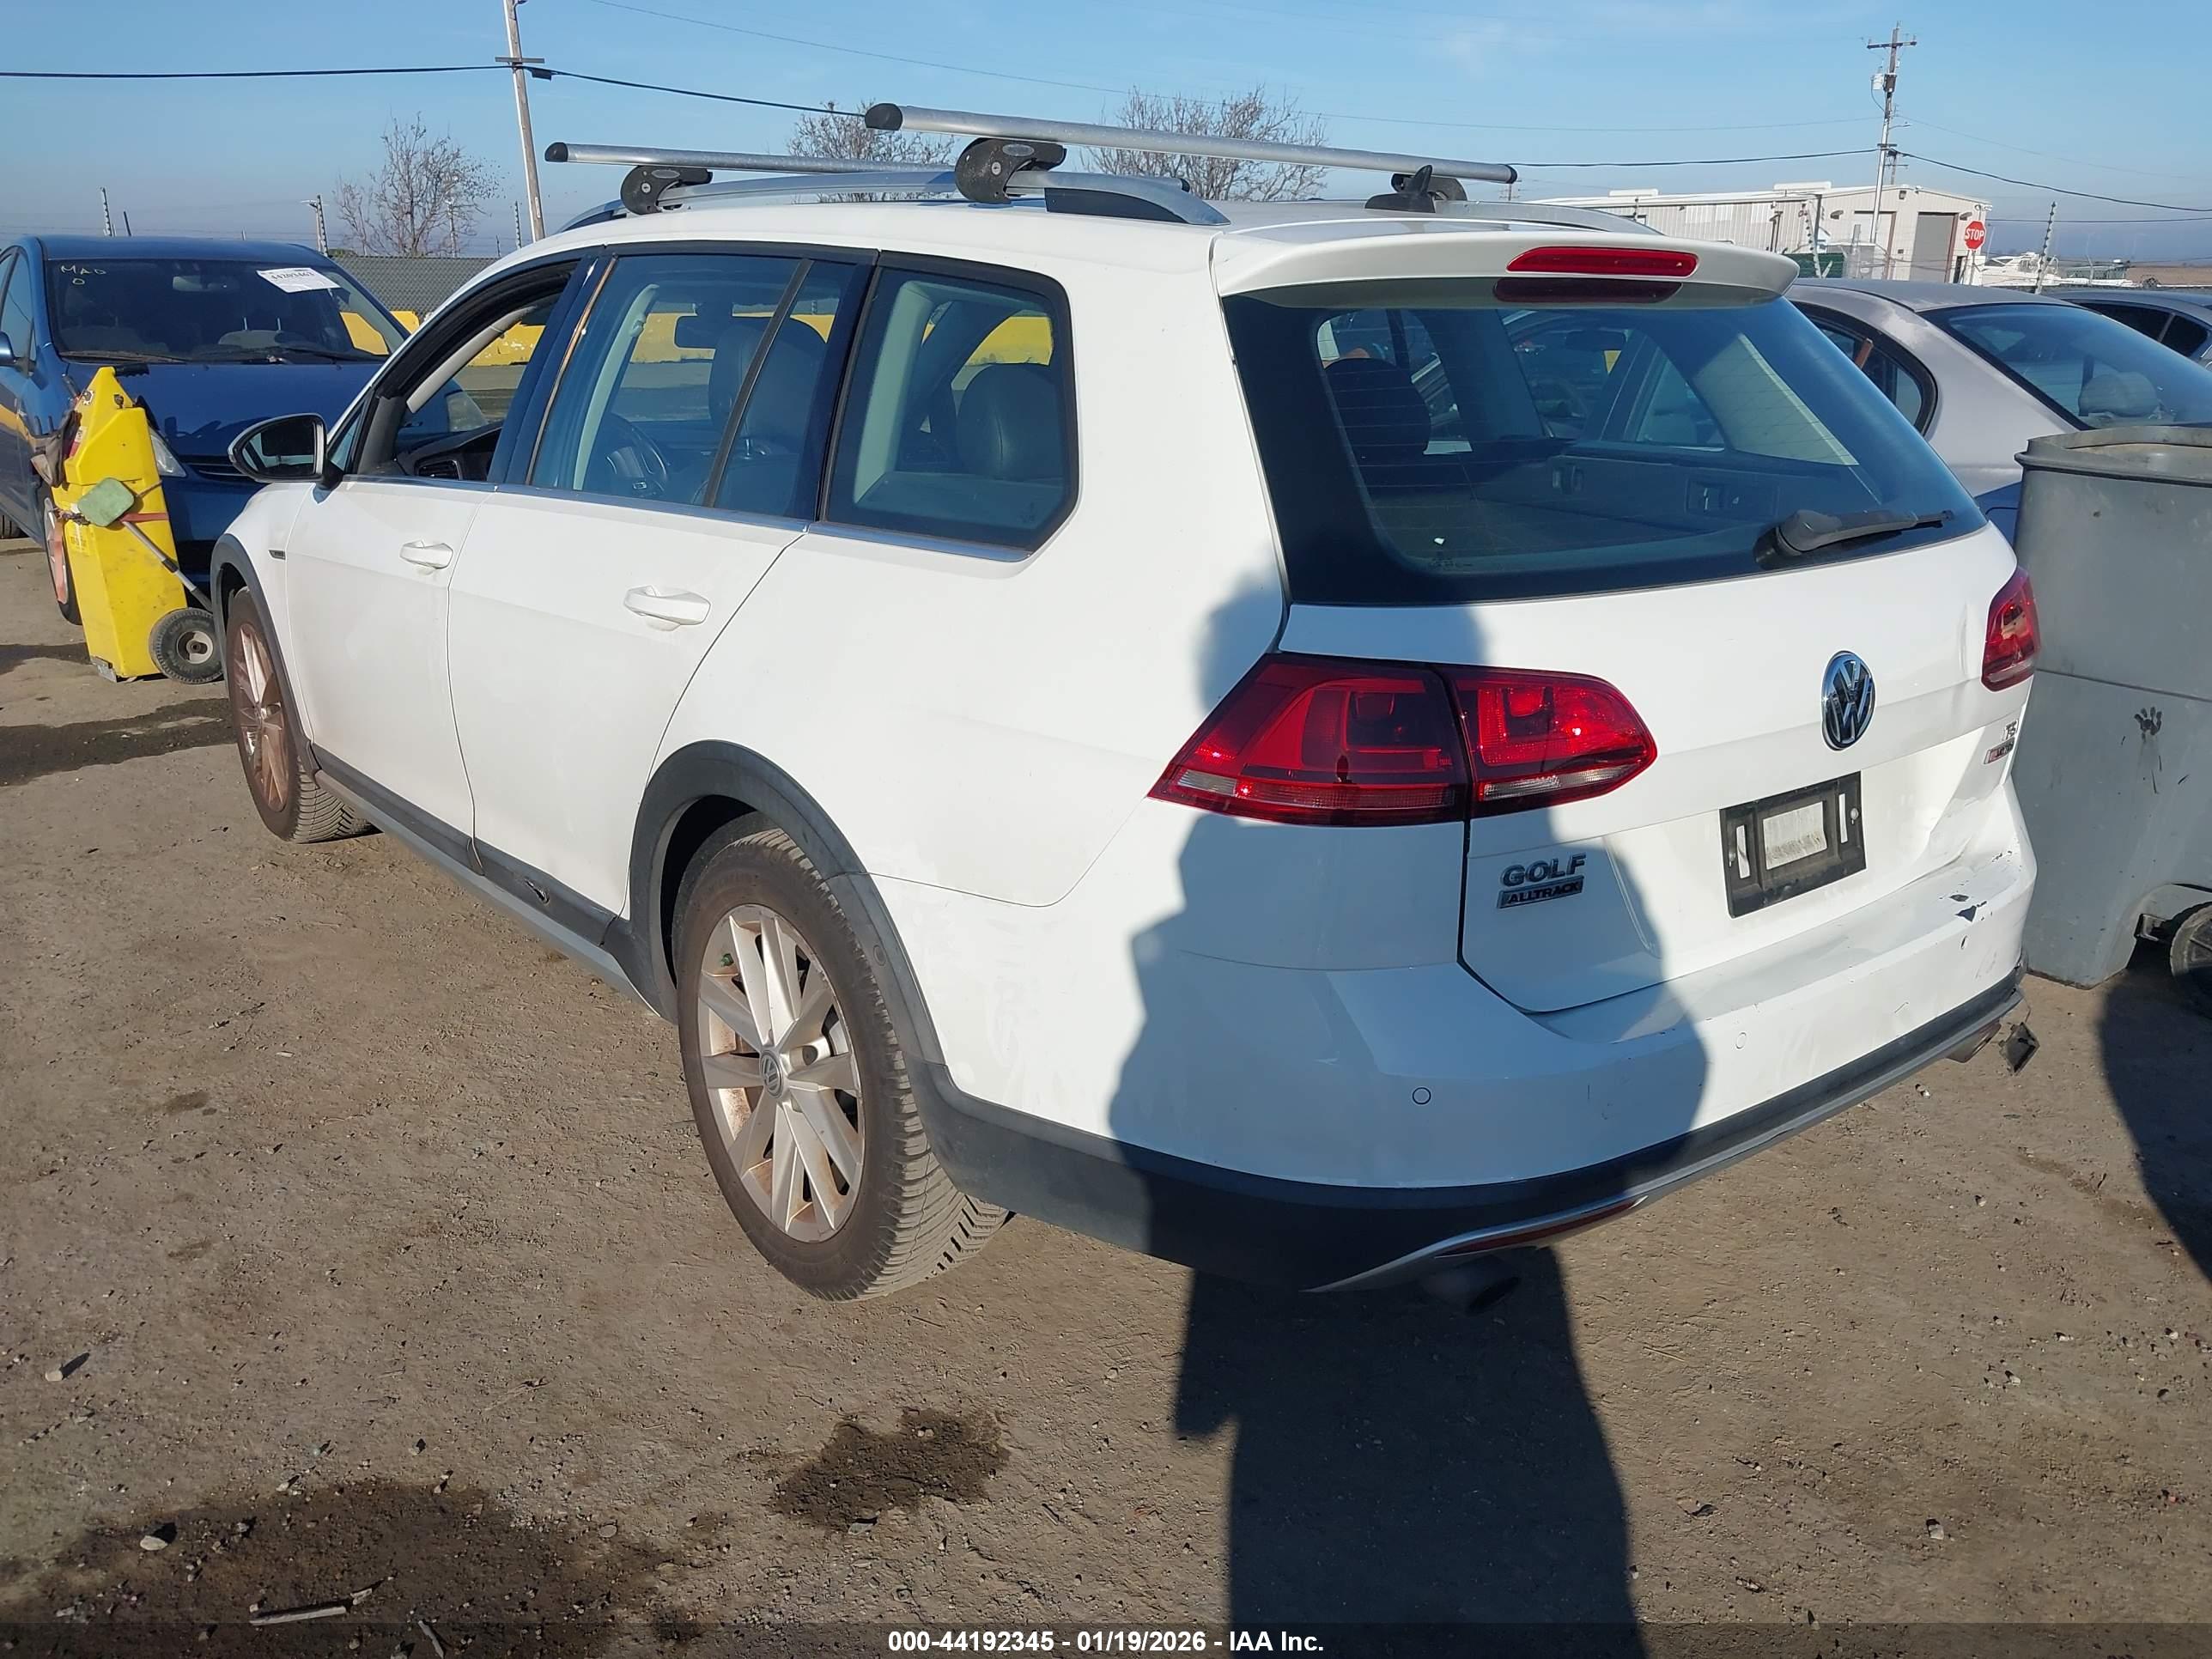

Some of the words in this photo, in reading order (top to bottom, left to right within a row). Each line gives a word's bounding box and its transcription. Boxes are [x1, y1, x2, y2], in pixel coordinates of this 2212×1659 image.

[1965, 228, 1984, 240] STOP
[1500, 853, 1586, 887] GOLF
[1506, 880, 1580, 905] ALLTRACK
